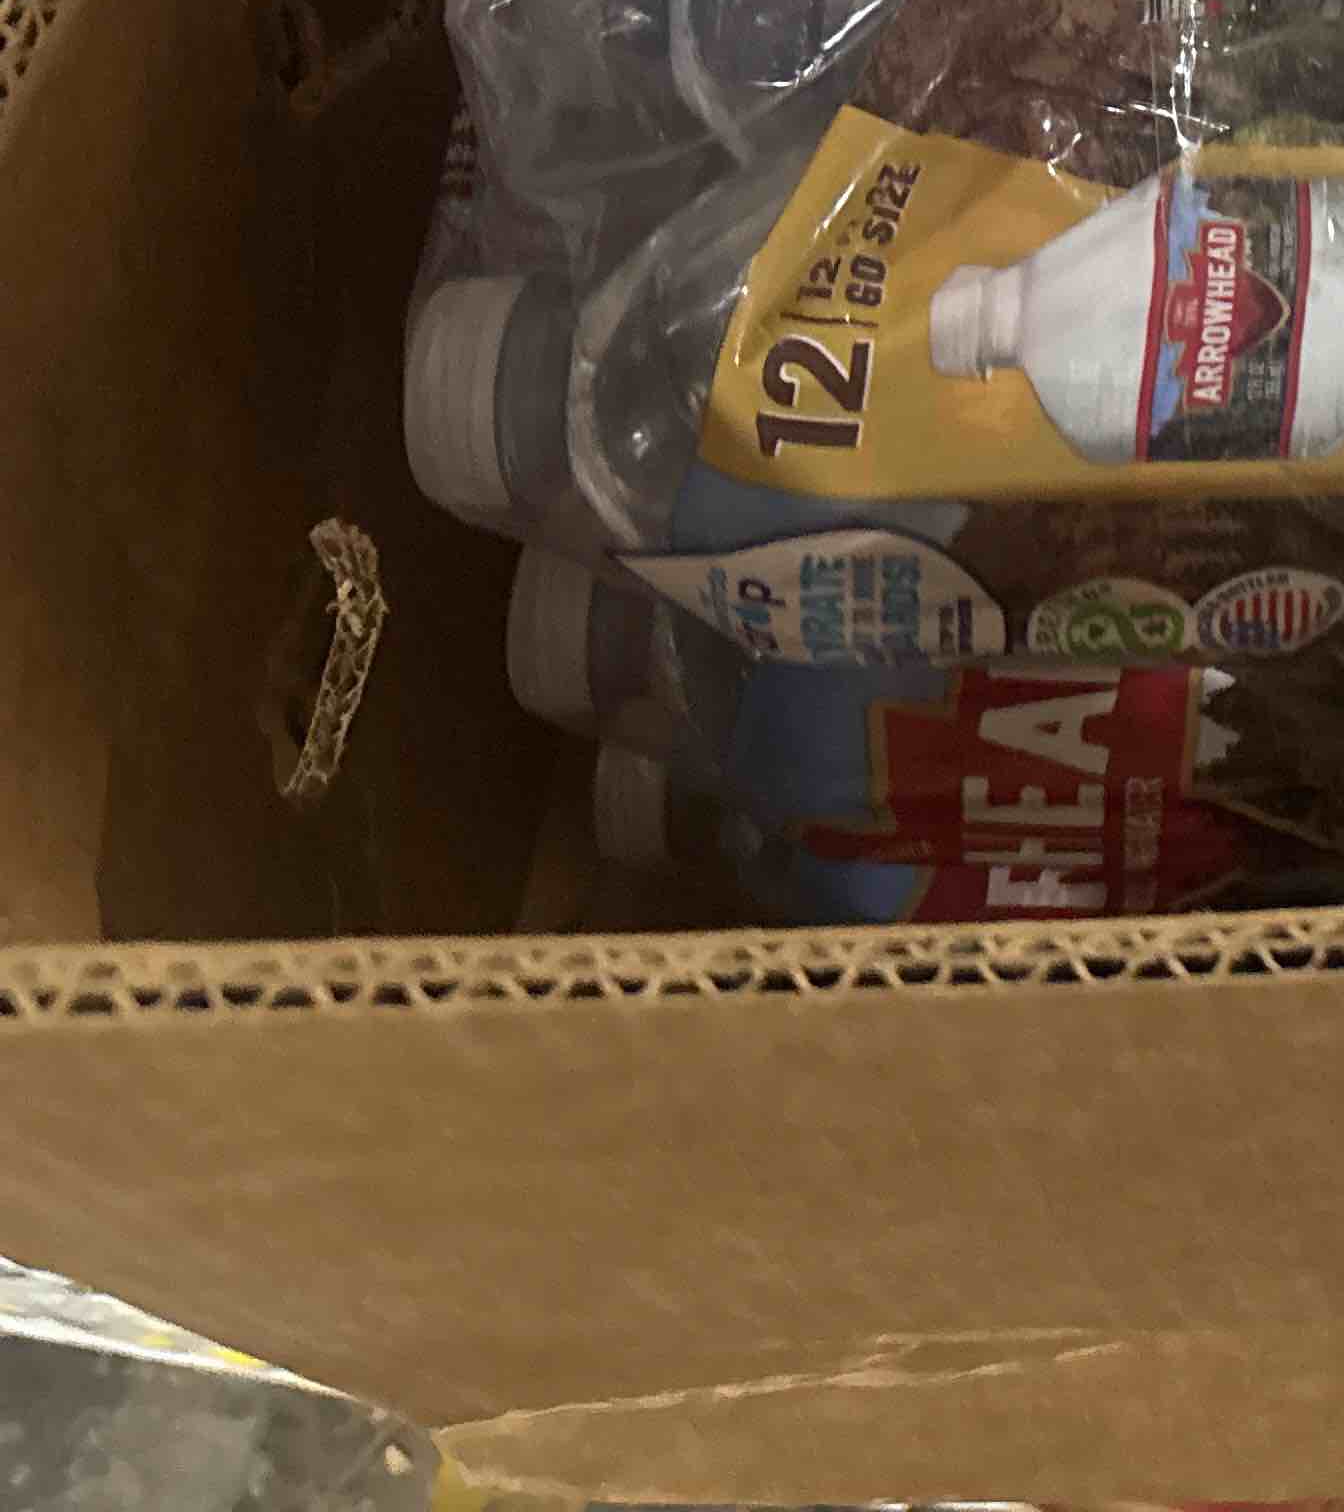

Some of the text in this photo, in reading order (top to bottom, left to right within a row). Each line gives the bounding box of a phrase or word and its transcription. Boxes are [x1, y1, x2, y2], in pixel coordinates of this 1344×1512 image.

[861, 161, 922, 247] SIZE
[795, 256, 841, 302] 12
[844, 253, 887, 308] GO
[1192, 227, 1238, 404] ARROWHEAD
[754, 334, 875, 459] 12
